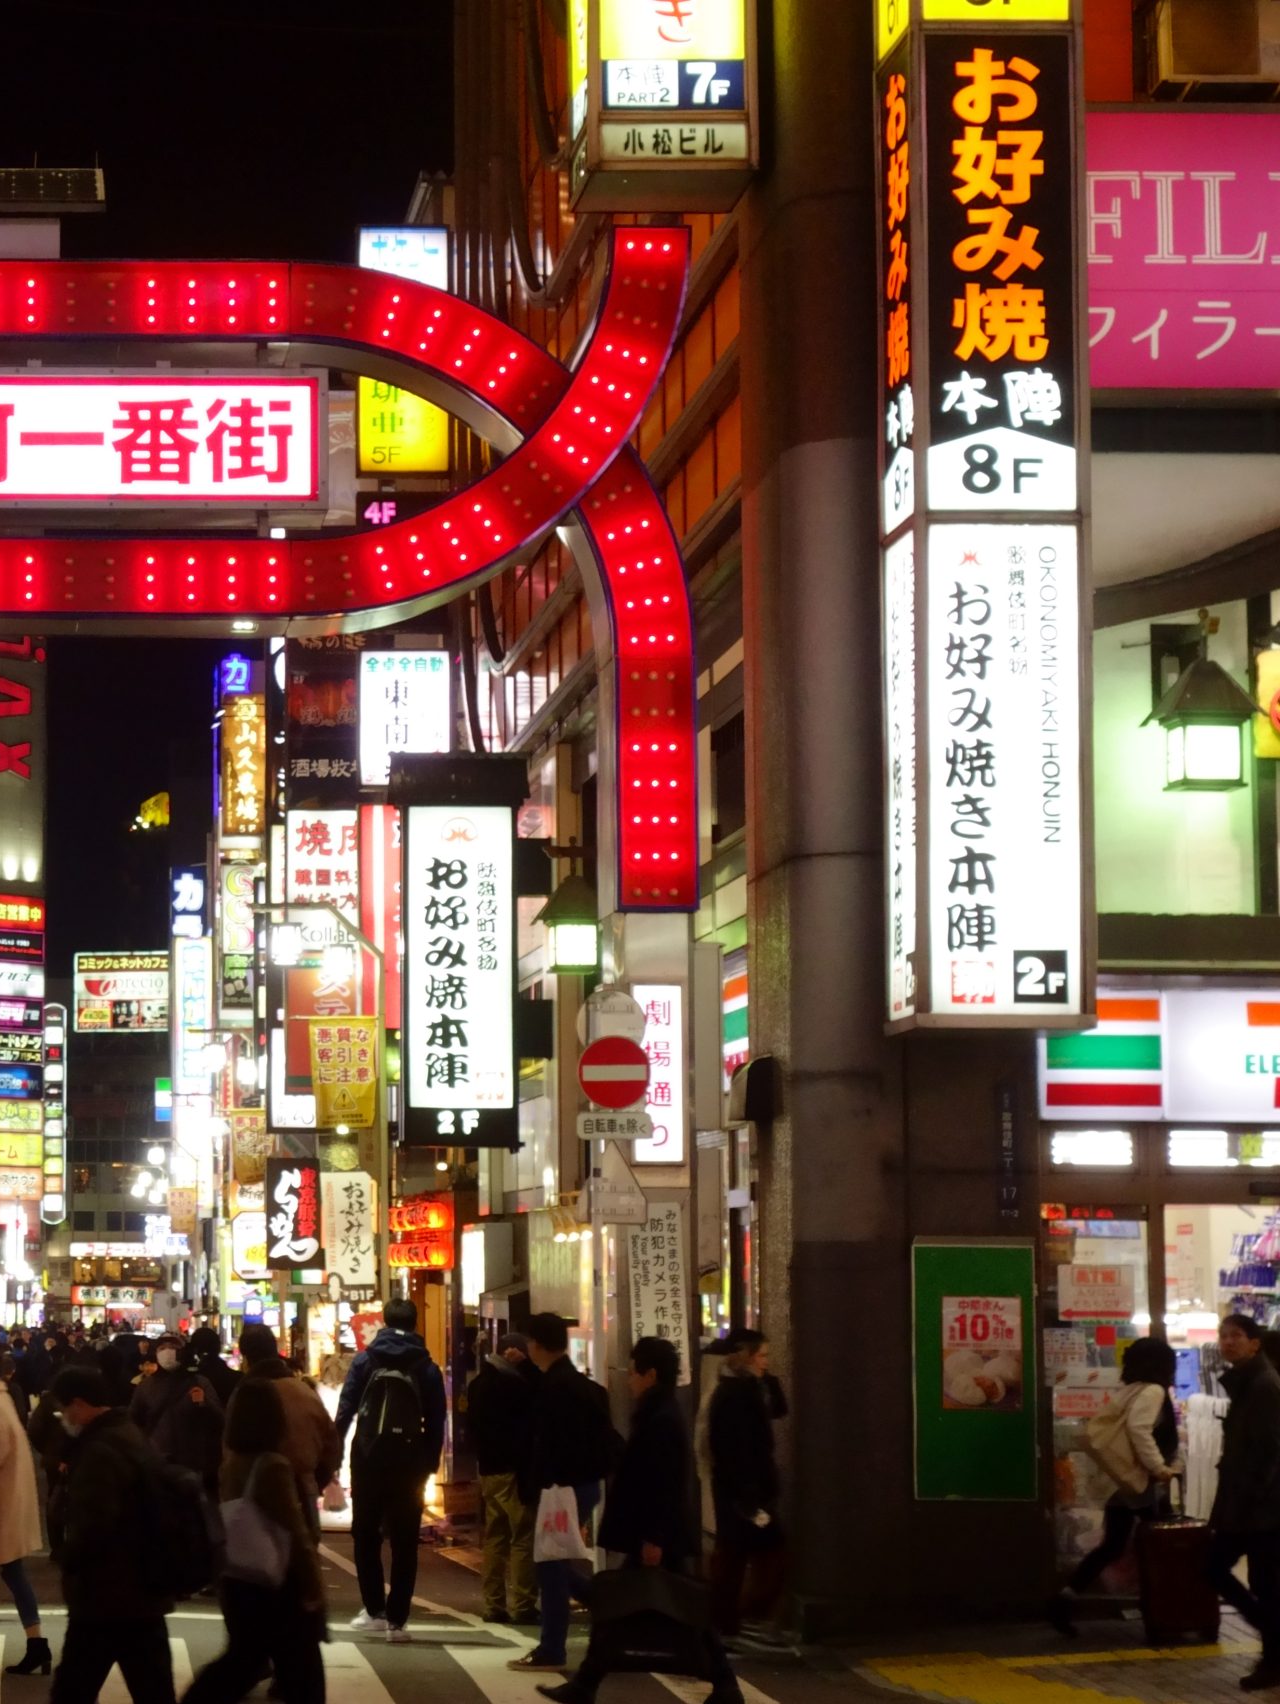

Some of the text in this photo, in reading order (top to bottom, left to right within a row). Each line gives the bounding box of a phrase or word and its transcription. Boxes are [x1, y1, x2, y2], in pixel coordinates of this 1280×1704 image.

[686, 62, 731, 104] 7F
[624, 128, 724, 155] 小松ビル
[952, 48, 1049, 362] お好み焼
[1087, 171, 1280, 264] FIL
[942, 367, 1062, 427] 本陣
[372, 446, 401, 464] 5F
[962, 443, 1044, 495] 8F
[365, 503, 396, 524] 4F
[1038, 545, 1062, 844] OKONOMIYAKI HONJIN
[944, 581, 997, 952] お好み焼き本陣
[295, 869, 358, 885] 韓国料
[425, 856, 470, 1090] お好み焼本陣
[1016, 956, 1066, 995] 2F
[317, 1027, 369, 1043] 悪質な
[317, 1047, 369, 1063] 客引き
[645, 999, 673, 1148] 劇場通り
[437, 1109, 480, 1136] 2F
[583, 1116, 647, 1136] 自転車を除く
[340, 1181, 372, 1274] お好み焼き
[632, 1273, 643, 1308] Camera
[641, 1259, 651, 1288] Safety
[650, 1218, 671, 1339] 防犯カメラ作動
[349, 1289, 374, 1299] B1F
